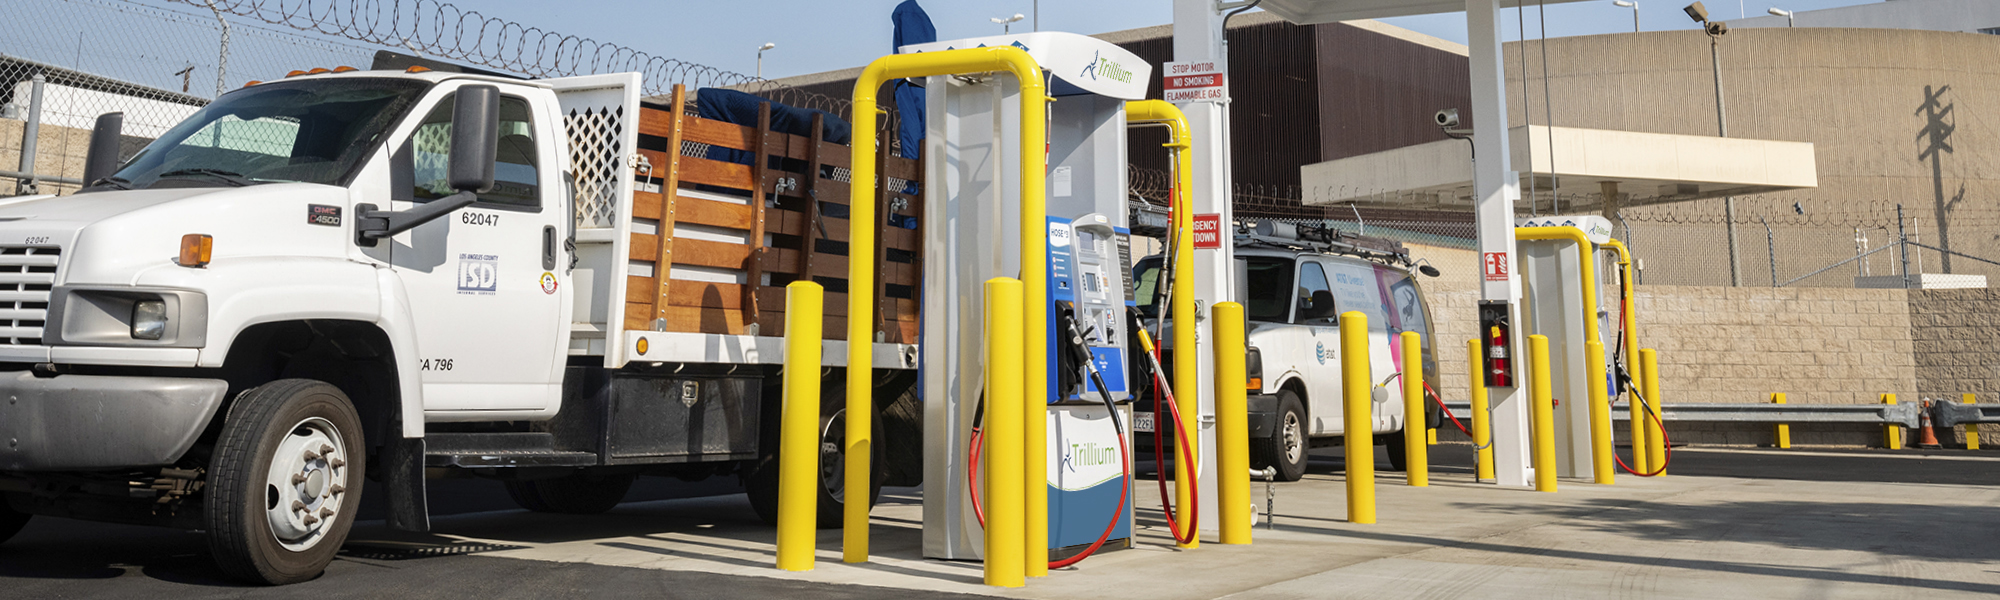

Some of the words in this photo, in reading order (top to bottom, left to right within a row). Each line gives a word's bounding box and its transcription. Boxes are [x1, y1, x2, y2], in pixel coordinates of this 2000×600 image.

[1097, 57, 1132, 84] Trillium
[1172, 64, 1189, 74] STOP
[1191, 62, 1214, 73] MOTOR
[1173, 78, 1182, 87] NO
[1184, 76, 1214, 87] SMOKING
[1167, 90, 1206, 101] FLAMMABLE
[1208, 89, 1221, 99] GAS
[314, 206, 336, 215] GMC
[309, 215, 340, 225] C4500
[462, 212, 499, 227] 62047
[1051, 228, 1063, 238] HOSE
[25, 236, 49, 245] 62047
[460, 261, 496, 288] ISD
[434, 358, 454, 371] 796
[1072, 442, 1116, 467] Trillium
